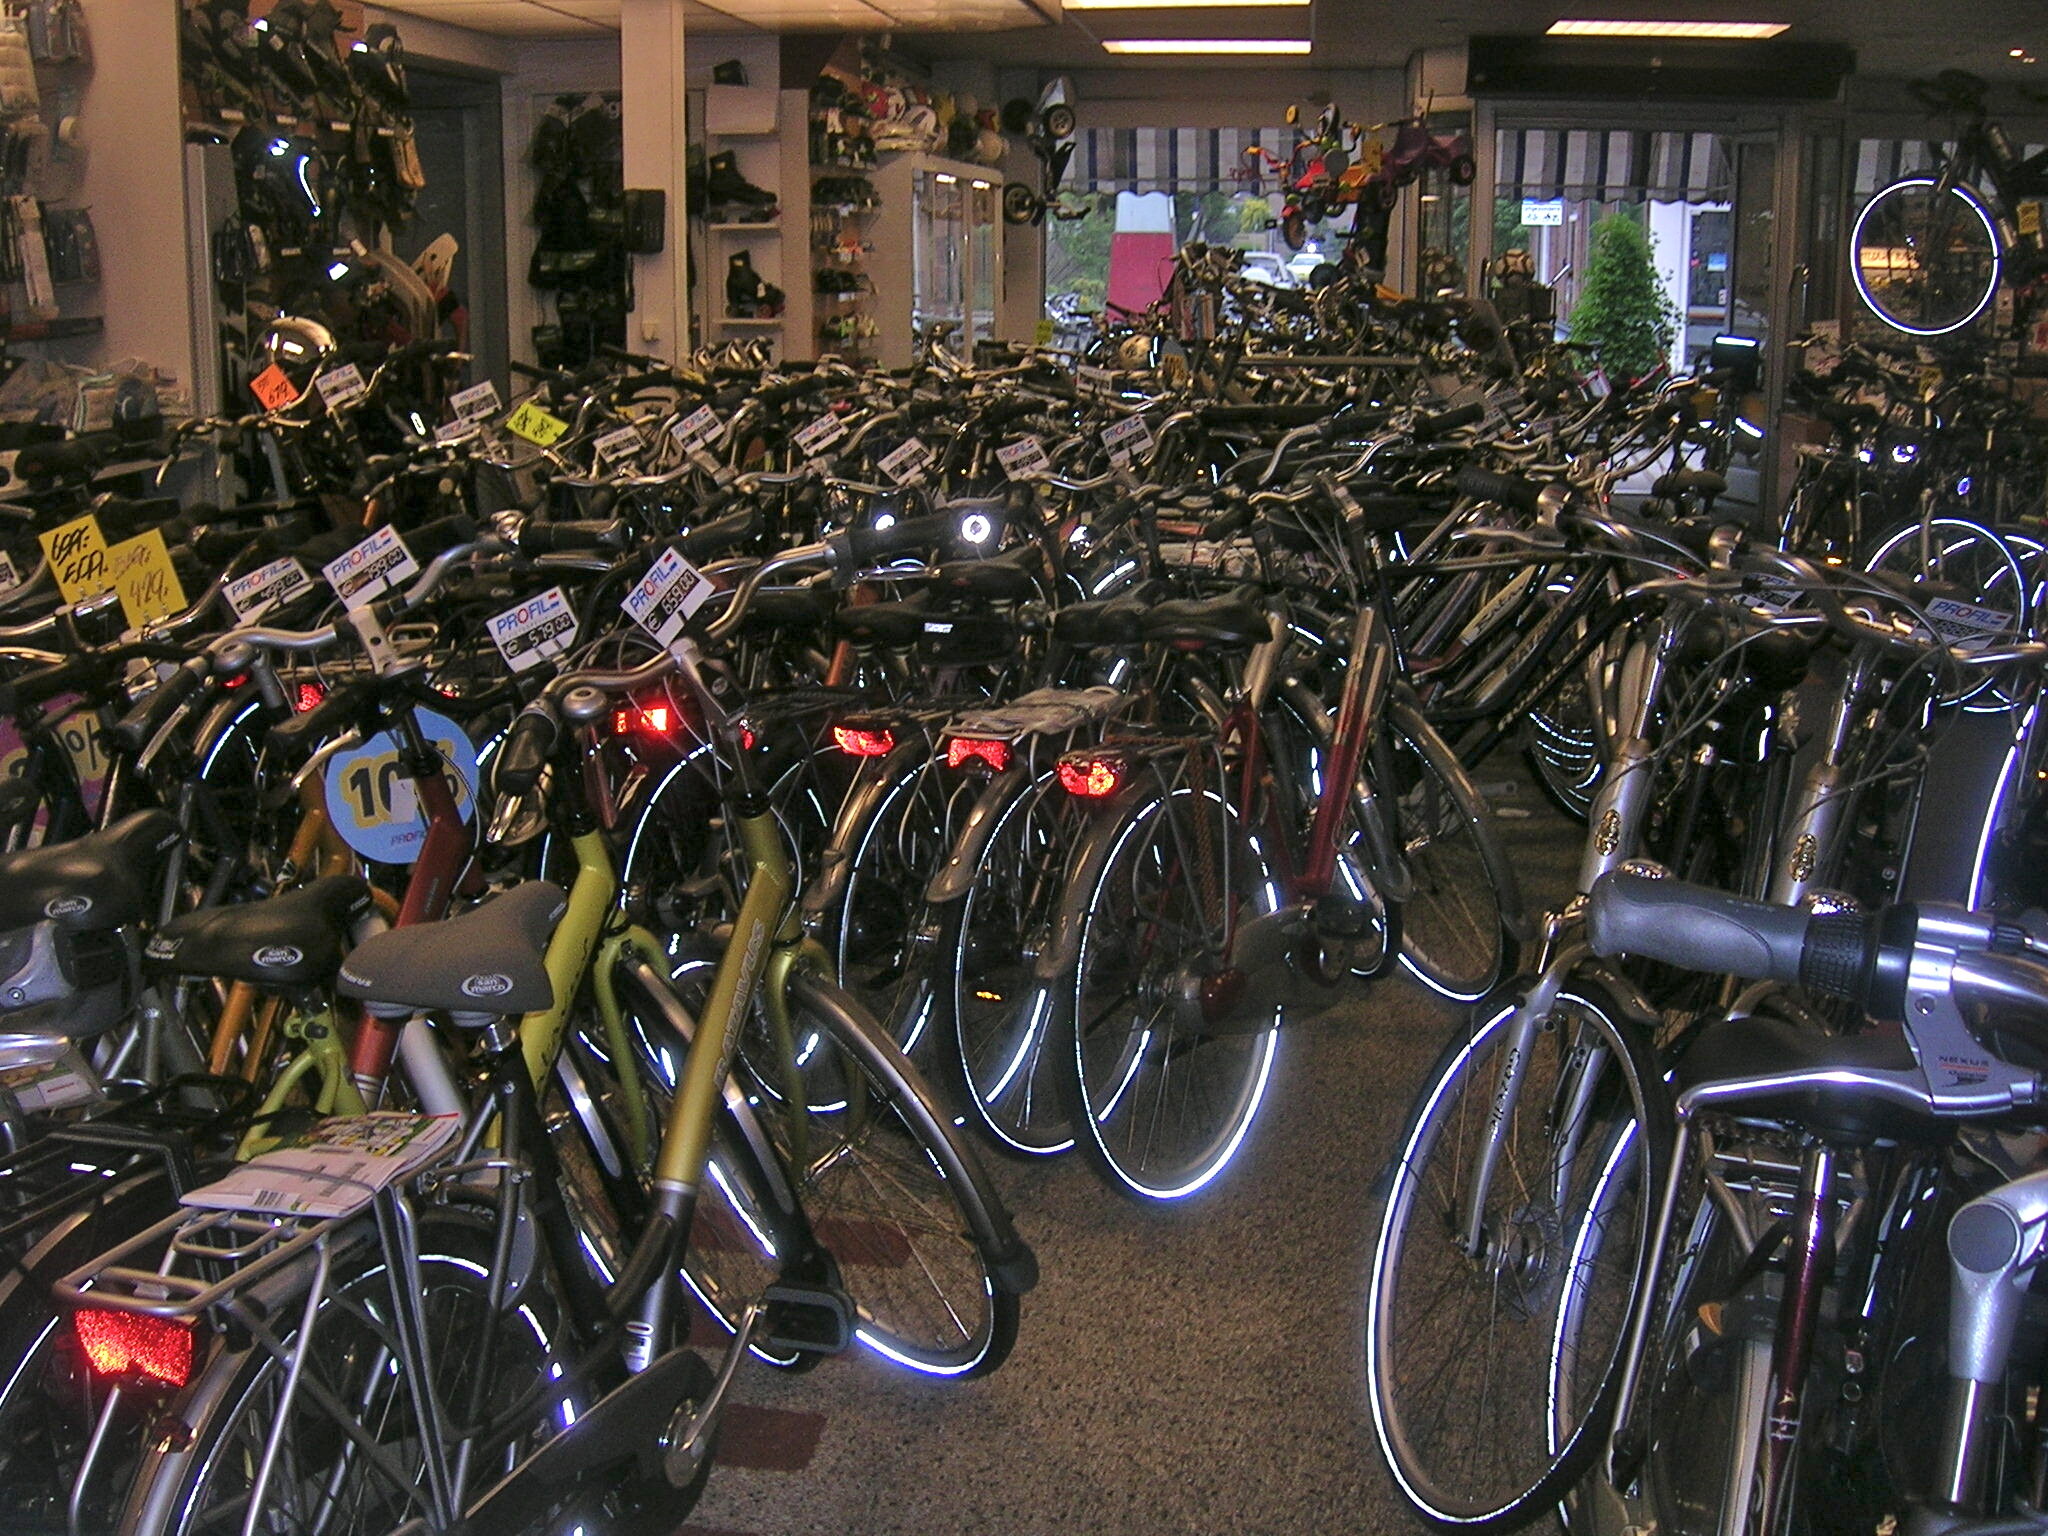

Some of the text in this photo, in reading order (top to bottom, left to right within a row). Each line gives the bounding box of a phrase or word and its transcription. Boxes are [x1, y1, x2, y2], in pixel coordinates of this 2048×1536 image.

[332, 540, 384, 578] PROFIL
[231, 565, 284, 596] PROFIL
[629, 565, 670, 613] PROFIL
[661, 573, 696, 616] 659.00
[496, 599, 552, 635] PROFIL
[1931, 601, 1992, 621] PROFIL
[527, 614, 571, 649] 579.00
